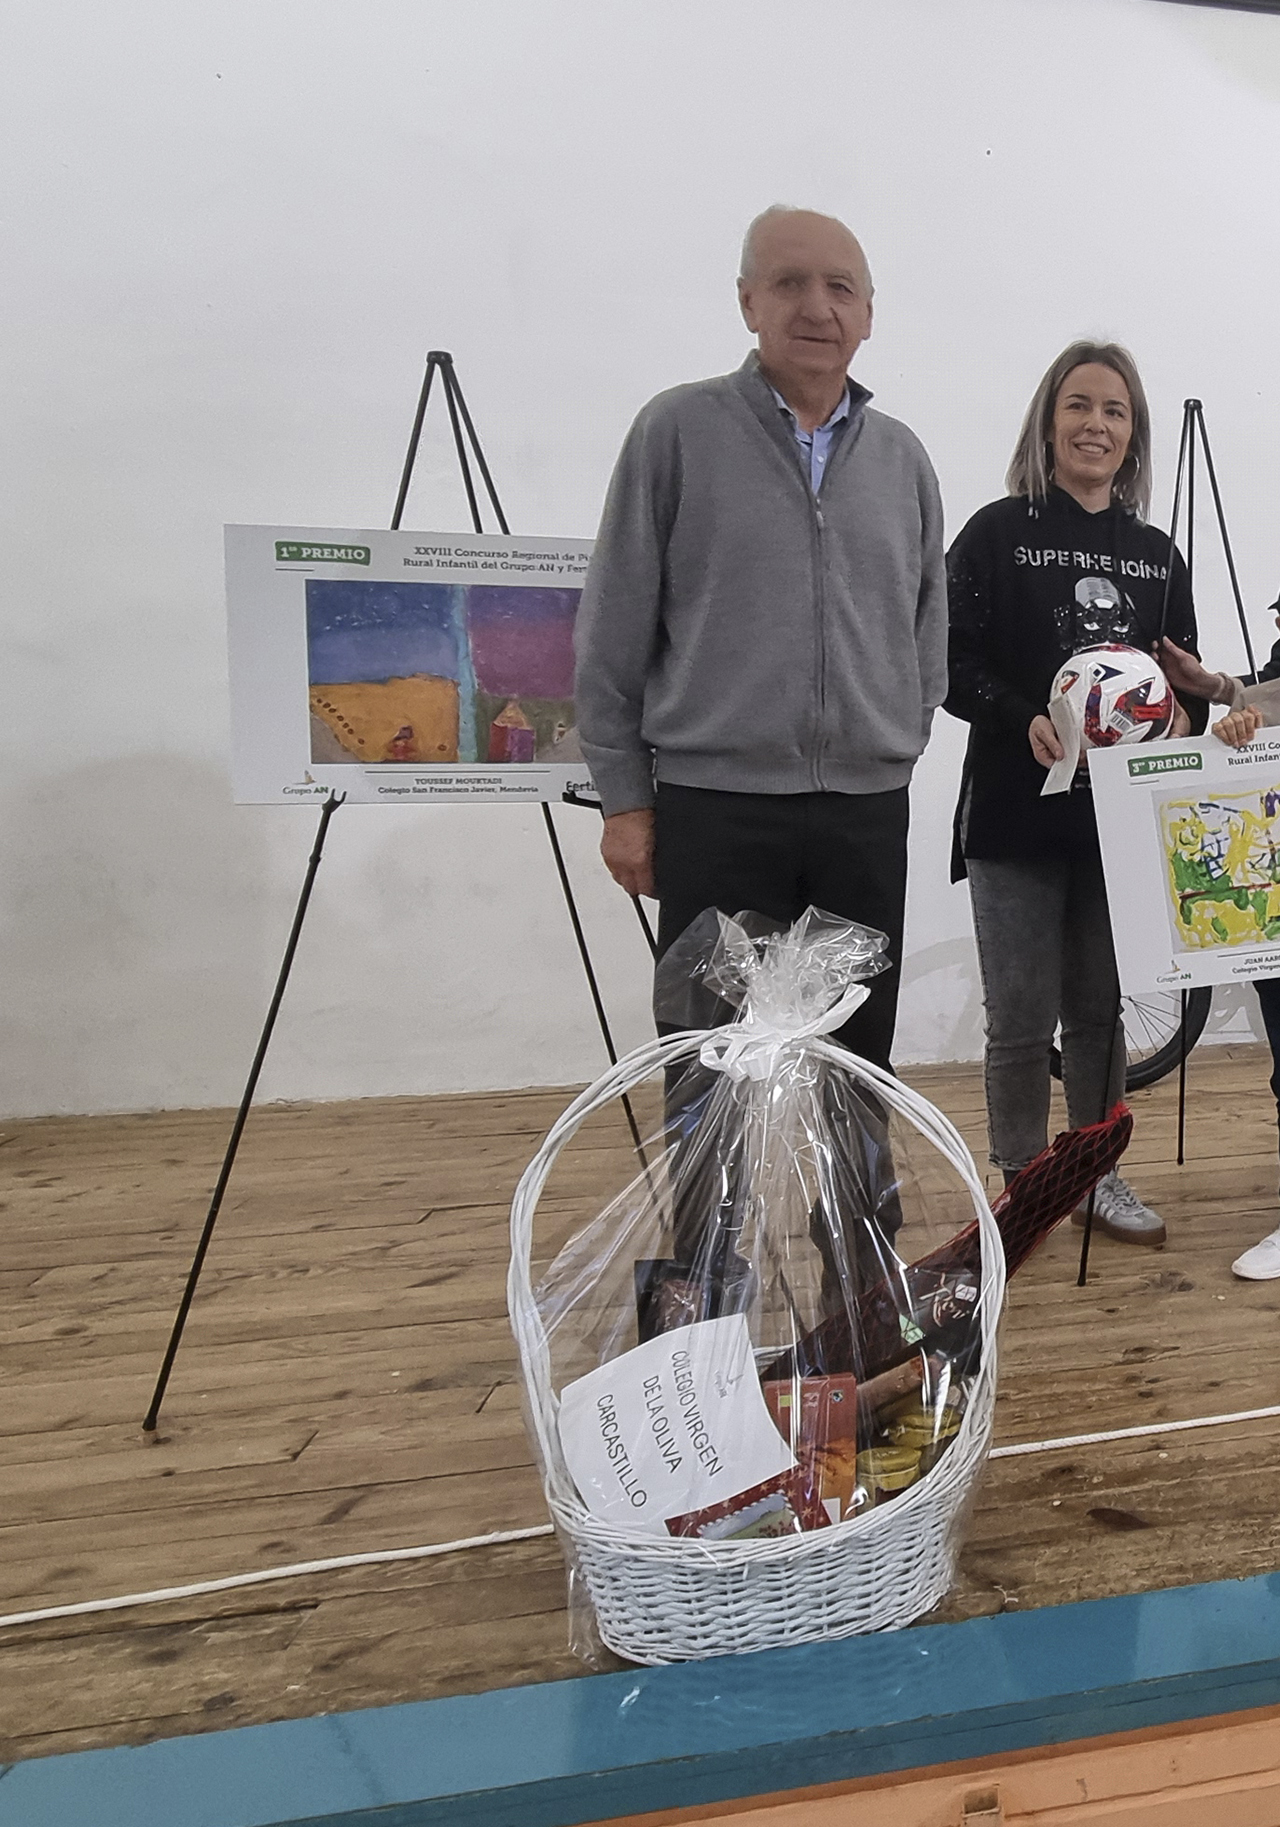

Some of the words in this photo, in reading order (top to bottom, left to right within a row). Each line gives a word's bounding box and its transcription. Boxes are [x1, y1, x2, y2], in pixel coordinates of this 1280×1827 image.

[301, 547, 365, 560] PREMIO
[413, 546, 452, 556] XXVIII
[454, 548, 509, 559] Concurso
[511, 551, 560, 562] Regional
[562, 553, 575, 562] de
[403, 558, 434, 568] Rural
[436, 558, 478, 569] Infantil
[481, 560, 498, 570] del
[500, 562, 536, 573] Grupo
[538, 563, 555, 572] AN
[557, 565, 564, 574] y
[1148, 756, 1199, 771] PREMIO
[1228, 756, 1253, 766] Rural
[283, 786, 312, 796] Grupo
[313, 786, 329, 794] AN
[378, 786, 409, 796] Colegio
[1180, 972, 1192, 980] AN
[1232, 965, 1258, 975] Colegio
[643, 1375, 662, 1398] DE
[671, 1350, 696, 1407] COLEGIO
[646, 1394, 665, 1419] LA
[651, 1416, 683, 1474] OLIVA
[683, 1403, 724, 1477] VIRGEN
[597, 1394, 648, 1508] CARCASTILLO
